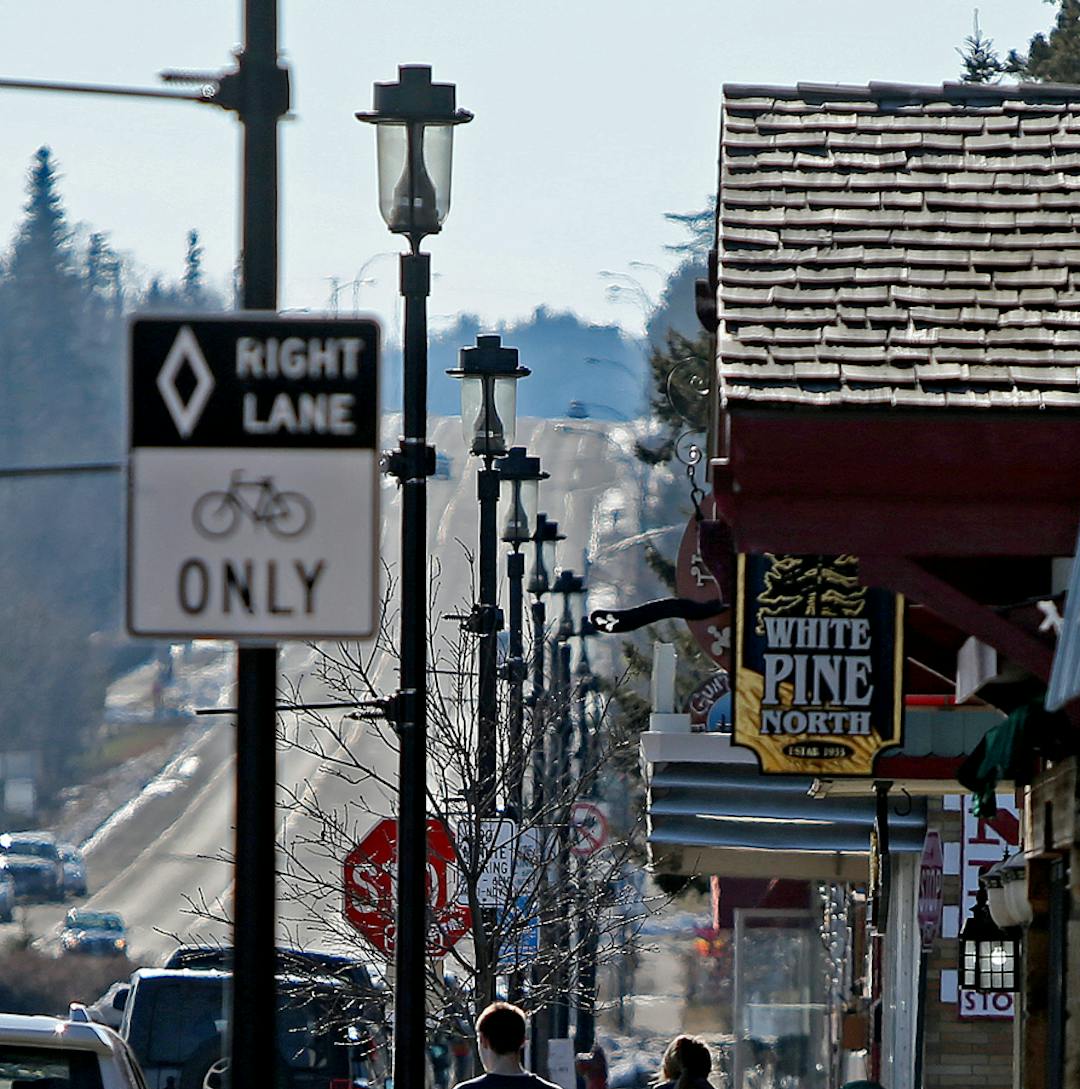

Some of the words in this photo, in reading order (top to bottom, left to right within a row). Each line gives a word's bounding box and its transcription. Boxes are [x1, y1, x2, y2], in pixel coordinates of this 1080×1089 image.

[235, 337, 364, 380] RIGHT
[242, 392, 356, 435] LANE
[178, 557, 327, 616] ONLY
[763, 616, 872, 650] WHITE
[761, 653, 874, 706] PINE
[760, 709, 872, 735] NORTH
